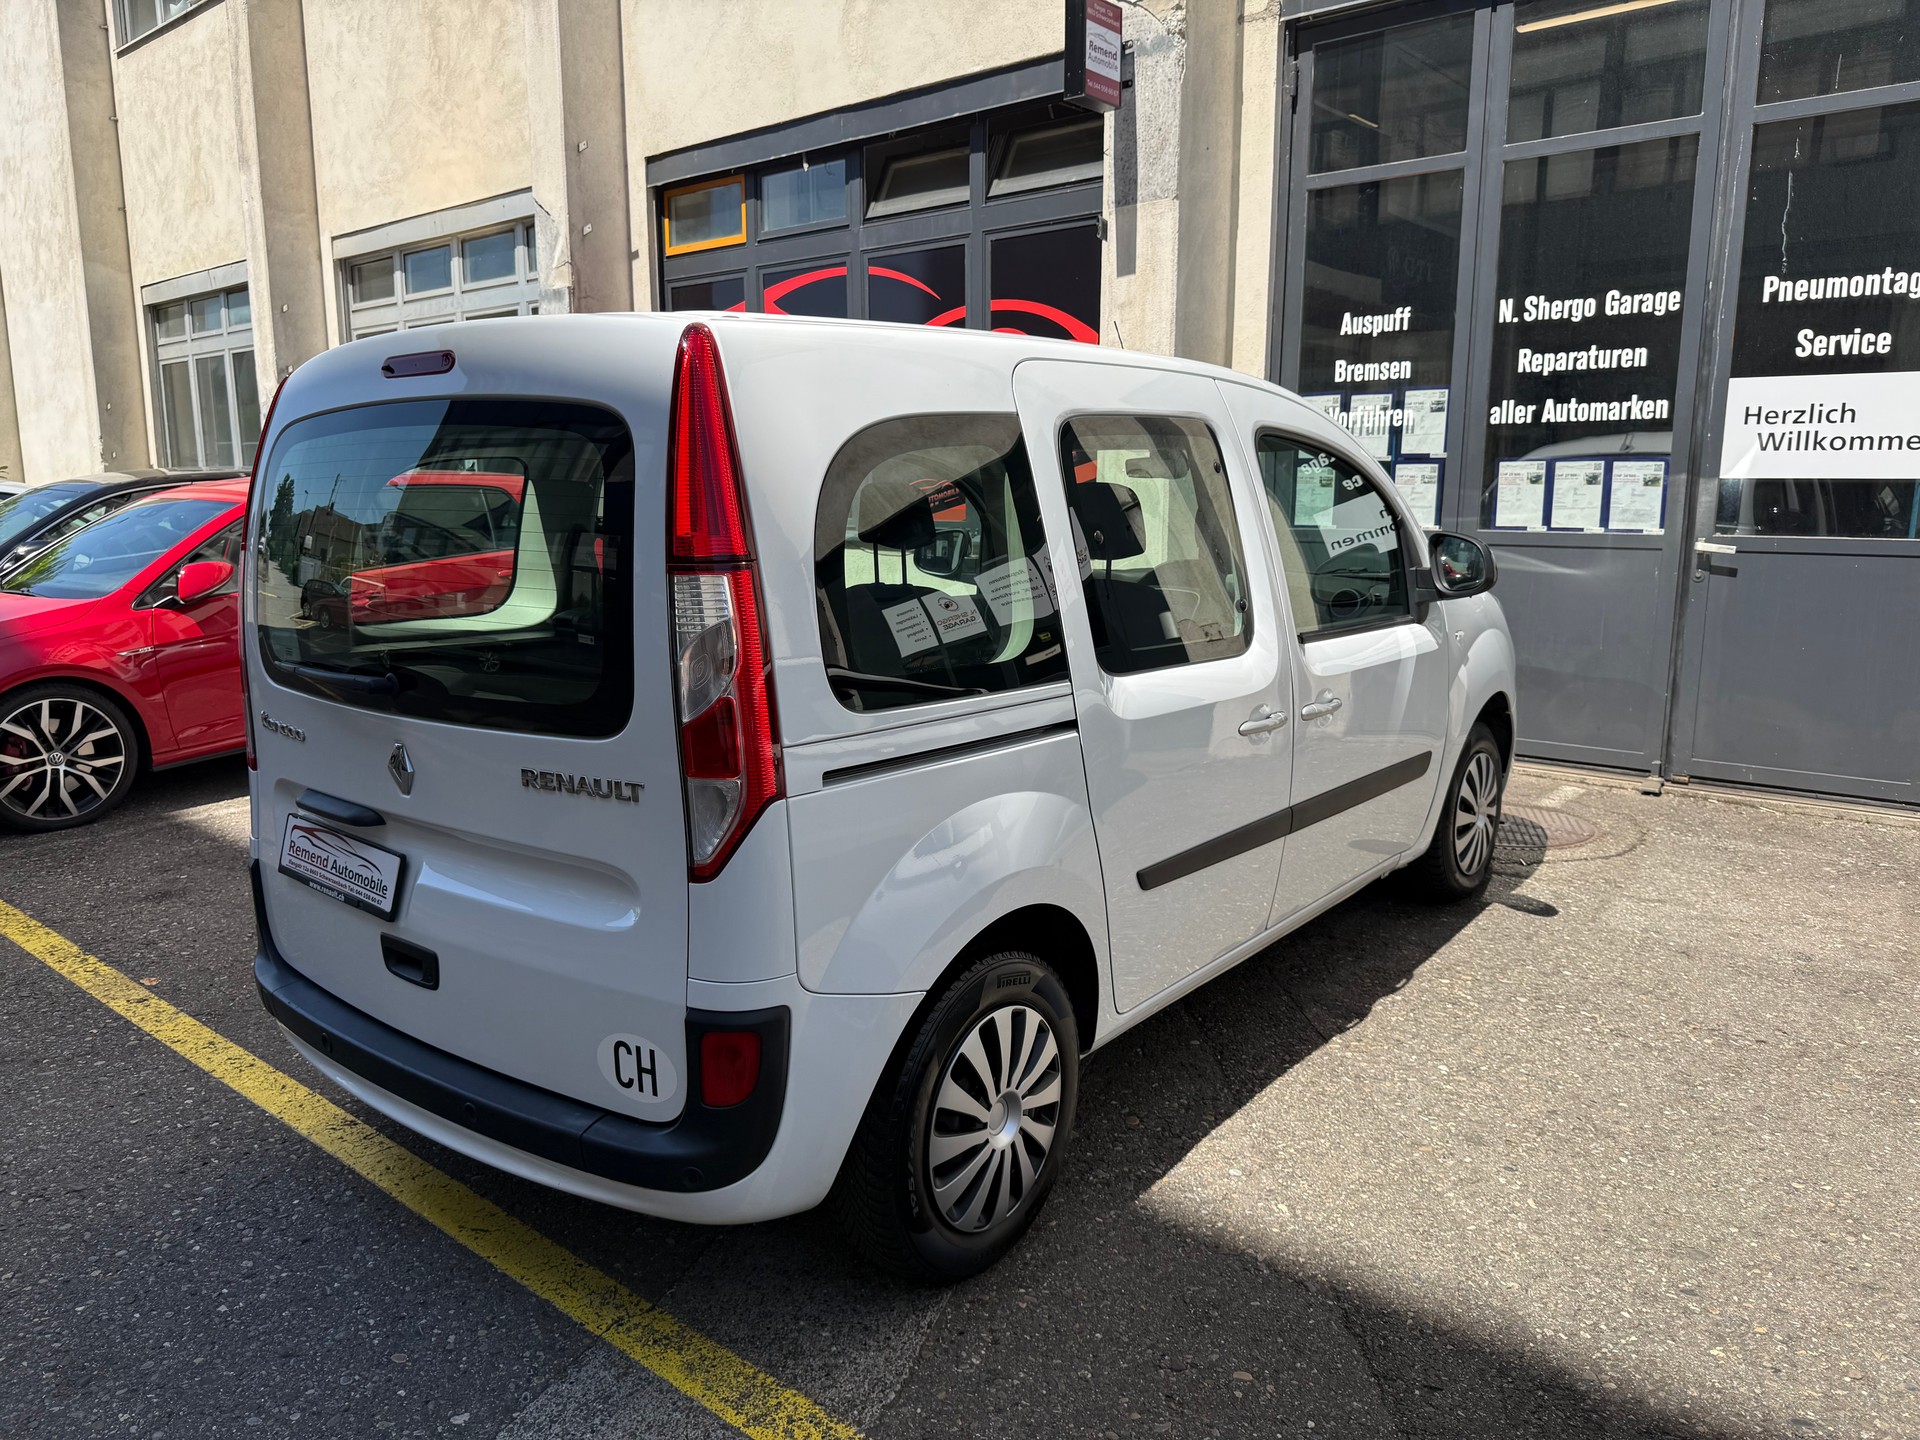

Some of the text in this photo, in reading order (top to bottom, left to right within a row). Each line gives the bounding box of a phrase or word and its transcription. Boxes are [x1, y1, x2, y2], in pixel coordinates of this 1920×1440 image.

[1087, 52, 1119, 73] Automobile
[1088, 40, 1118, 61] Remend
[1762, 266, 1920, 303] Pneumontag
[1339, 306, 1412, 337] Auspuff
[1498, 288, 1681, 325] N. Shergo Garage
[1795, 327, 1892, 358] Service
[1334, 359, 1412, 383] Bremsen
[1517, 344, 1647, 376] Reparaturen
[1328, 404, 1415, 429] Vorführen
[1489, 393, 1669, 426] aller Automarken
[1743, 402, 1857, 426] Herzlich
[1757, 430, 1920, 452] Willkomme
[520, 766, 645, 804] RENAULT
[288, 839, 388, 896] Remend Automobile
[355, 889, 363, 897] 044
[996, 970, 1031, 989] PIRELLI
[612, 1039, 659, 1098] CH
